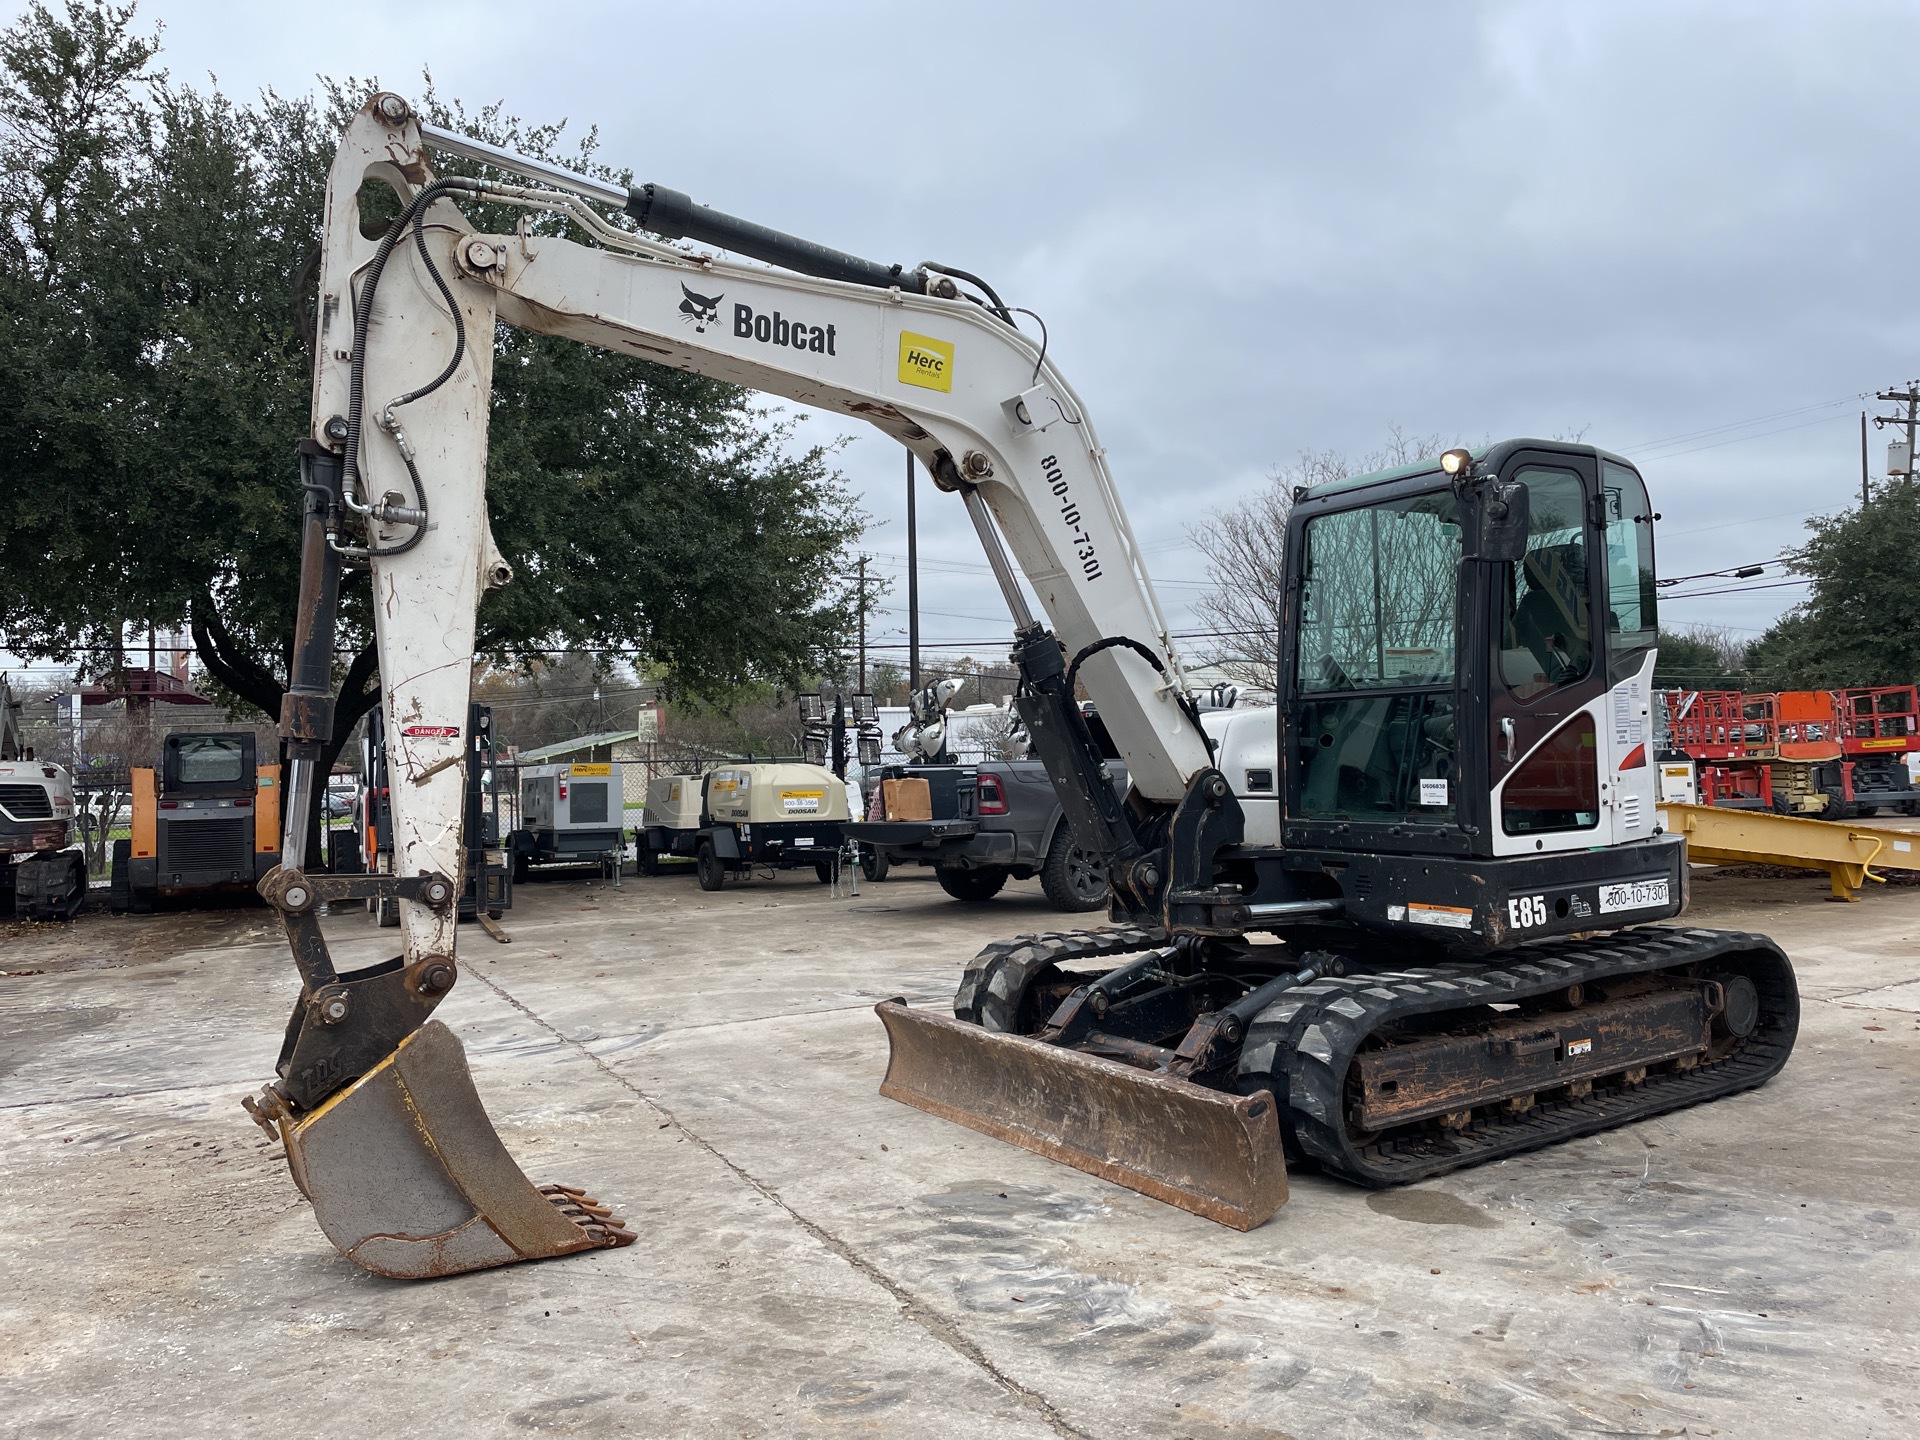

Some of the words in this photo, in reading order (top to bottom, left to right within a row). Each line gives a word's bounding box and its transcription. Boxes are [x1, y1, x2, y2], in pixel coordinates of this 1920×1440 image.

[734, 303, 836, 356] Bobcat
[907, 350, 944, 371] Herc
[916, 367, 940, 378] Rentals
[1041, 455, 1102, 582] 800-10-7301
[731, 809, 748, 817] DOOSAN
[1508, 895, 1547, 929] E85
